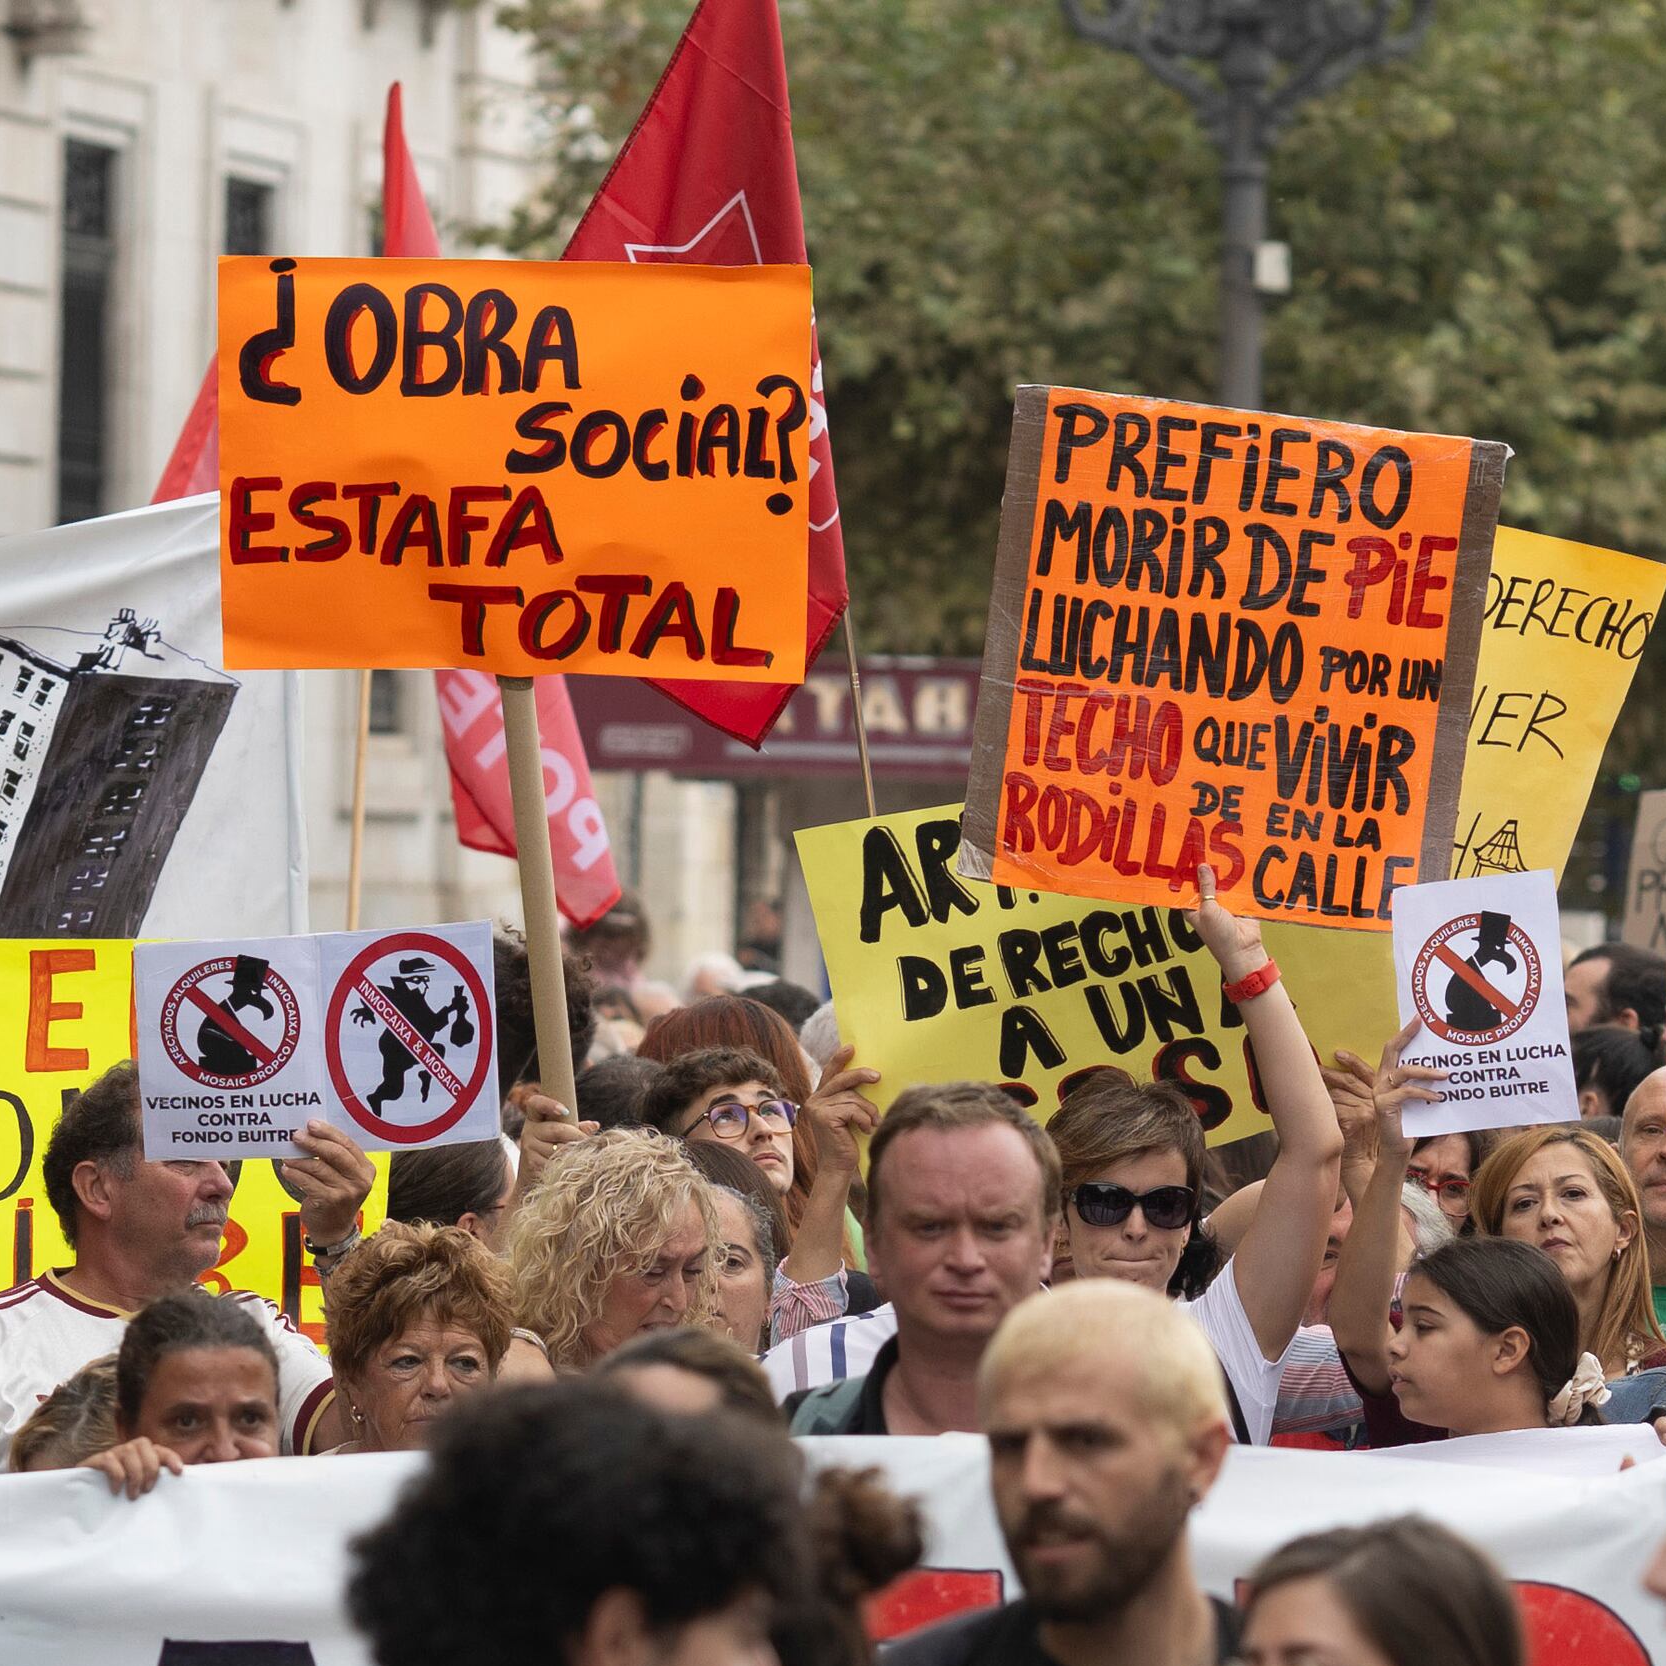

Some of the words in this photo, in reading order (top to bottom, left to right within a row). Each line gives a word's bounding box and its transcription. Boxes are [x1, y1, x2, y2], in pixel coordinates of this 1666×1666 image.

[230, 477, 564, 568] ESTAFA
[1239, 522, 1336, 617] DE
[429, 575, 773, 668] TOTAL
[1019, 588, 1305, 704] LUCHANDO
[1319, 646, 1391, 697] POR
[1397, 658, 1444, 703] UN
[1016, 678, 1184, 787] TECHO
[1193, 716, 1272, 771] QUE
[1190, 781, 1245, 822] DE
[1266, 803, 1325, 842] EN
[1332, 814, 1383, 852] LA
[1251, 844, 1416, 920] CALLE
[1422, 917, 1477, 960] ALQUILERES
[1510, 929, 1538, 990] INMOCAIXA
[358, 979, 412, 1044] INMOCAIXA
[422, 1049, 462, 1097] MOSAIC
[999, 1004, 1068, 1079] A
[1401, 1053, 1473, 1069] VECINOS
[1478, 1050, 1504, 1064] EN
[1507, 1044, 1567, 1061] LUCHA
[1446, 1030, 1494, 1044] MOSAIC
[198, 1071, 248, 1088] MOSAIC
[1426, 1088, 1485, 1105] ONDO
[1490, 1081, 1550, 1099] BUITRE
[1448, 1066, 1521, 1086] CONTRA
[146, 1096, 227, 1110] VECINOS
[231, 1095, 257, 1109] EN
[259, 1091, 322, 1106] LUCHA
[197, 1112, 273, 1127] CONTRA
[171, 1130, 233, 1144] FONDO
